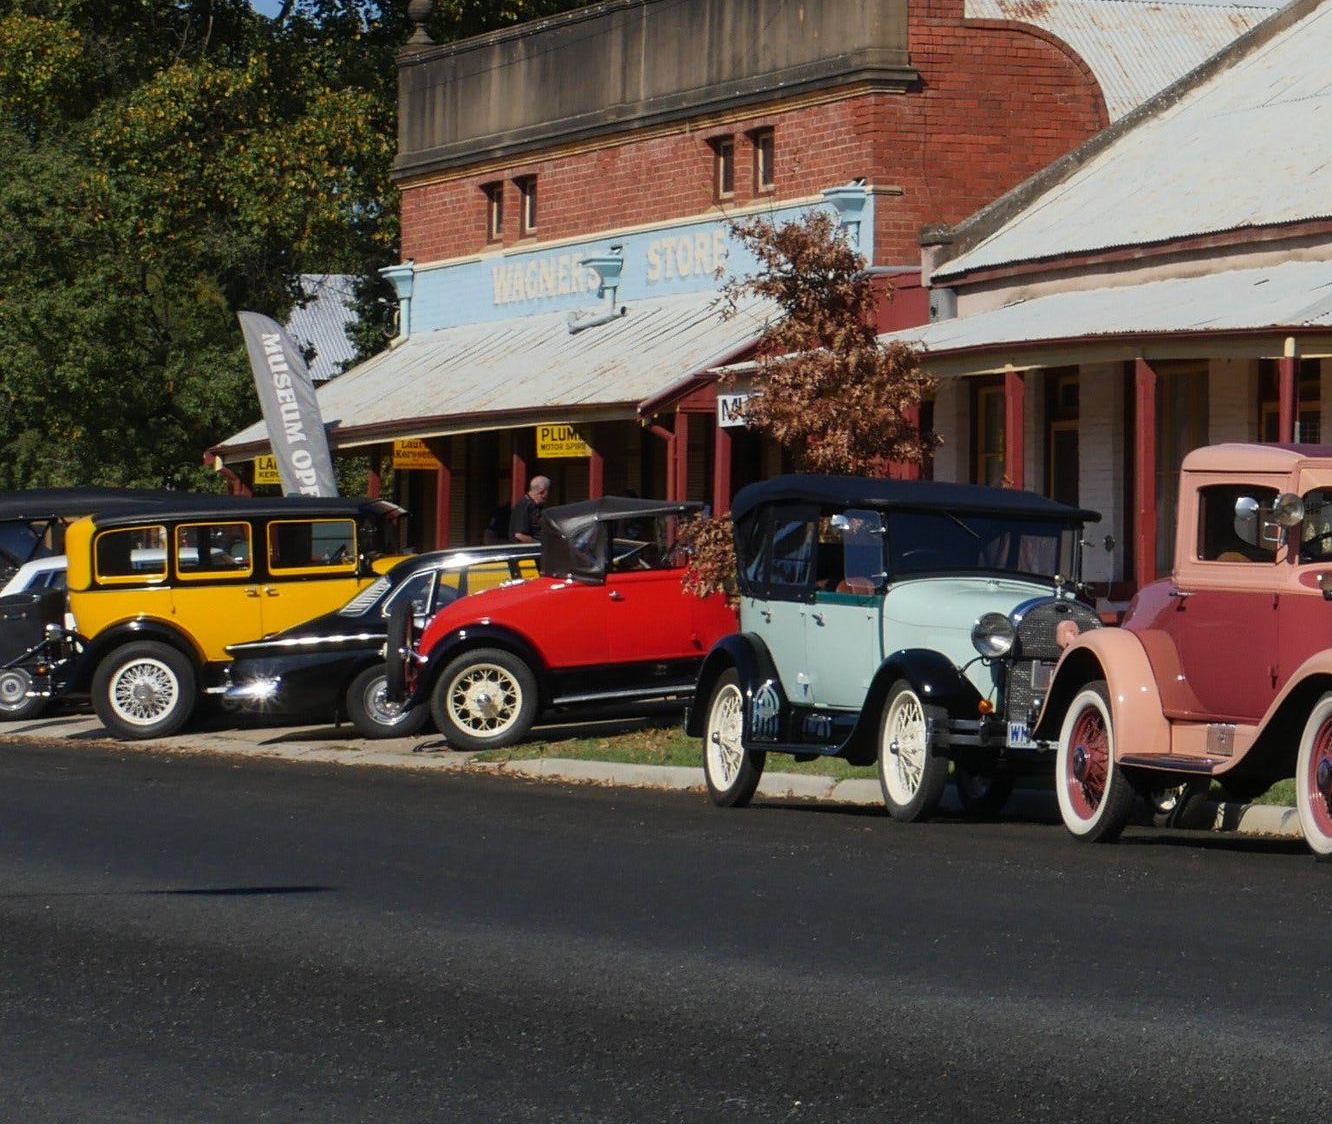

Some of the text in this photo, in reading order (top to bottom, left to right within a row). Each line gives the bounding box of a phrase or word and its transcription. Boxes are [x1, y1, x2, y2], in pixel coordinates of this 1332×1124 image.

[645, 230, 727, 282] STORE
[262, 332, 307, 445] MUSEUM
[291, 449, 320, 497] OPE
[541, 427, 579, 442] PLUM
